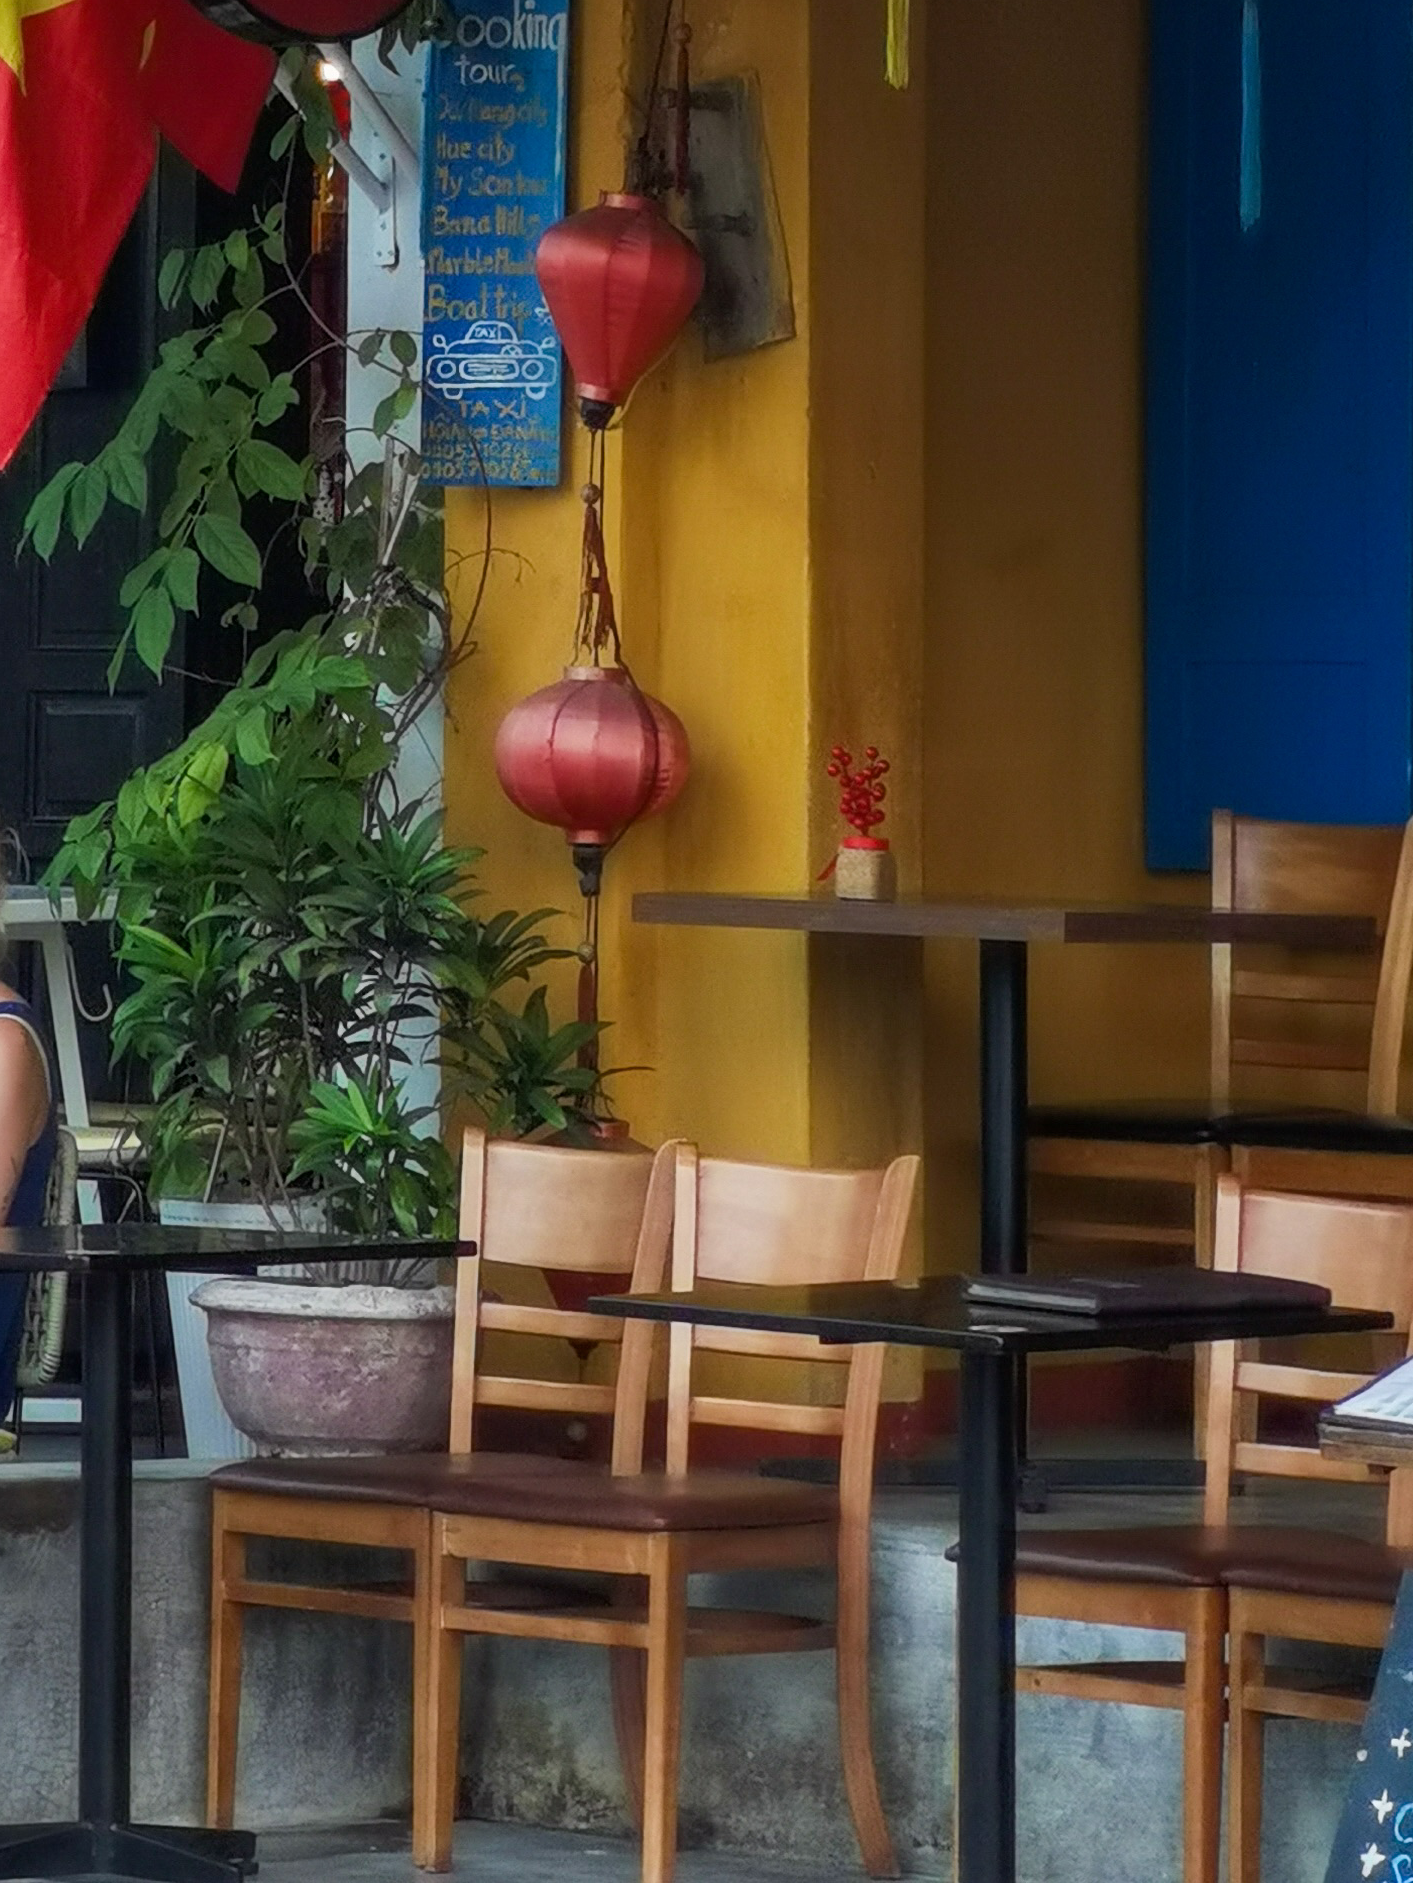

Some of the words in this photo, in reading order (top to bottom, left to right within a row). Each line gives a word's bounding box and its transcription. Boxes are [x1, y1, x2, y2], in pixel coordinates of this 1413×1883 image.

[435, 132, 472, 160] Hue
[477, 131, 516, 167] city
[427, 282, 488, 323] Boat
